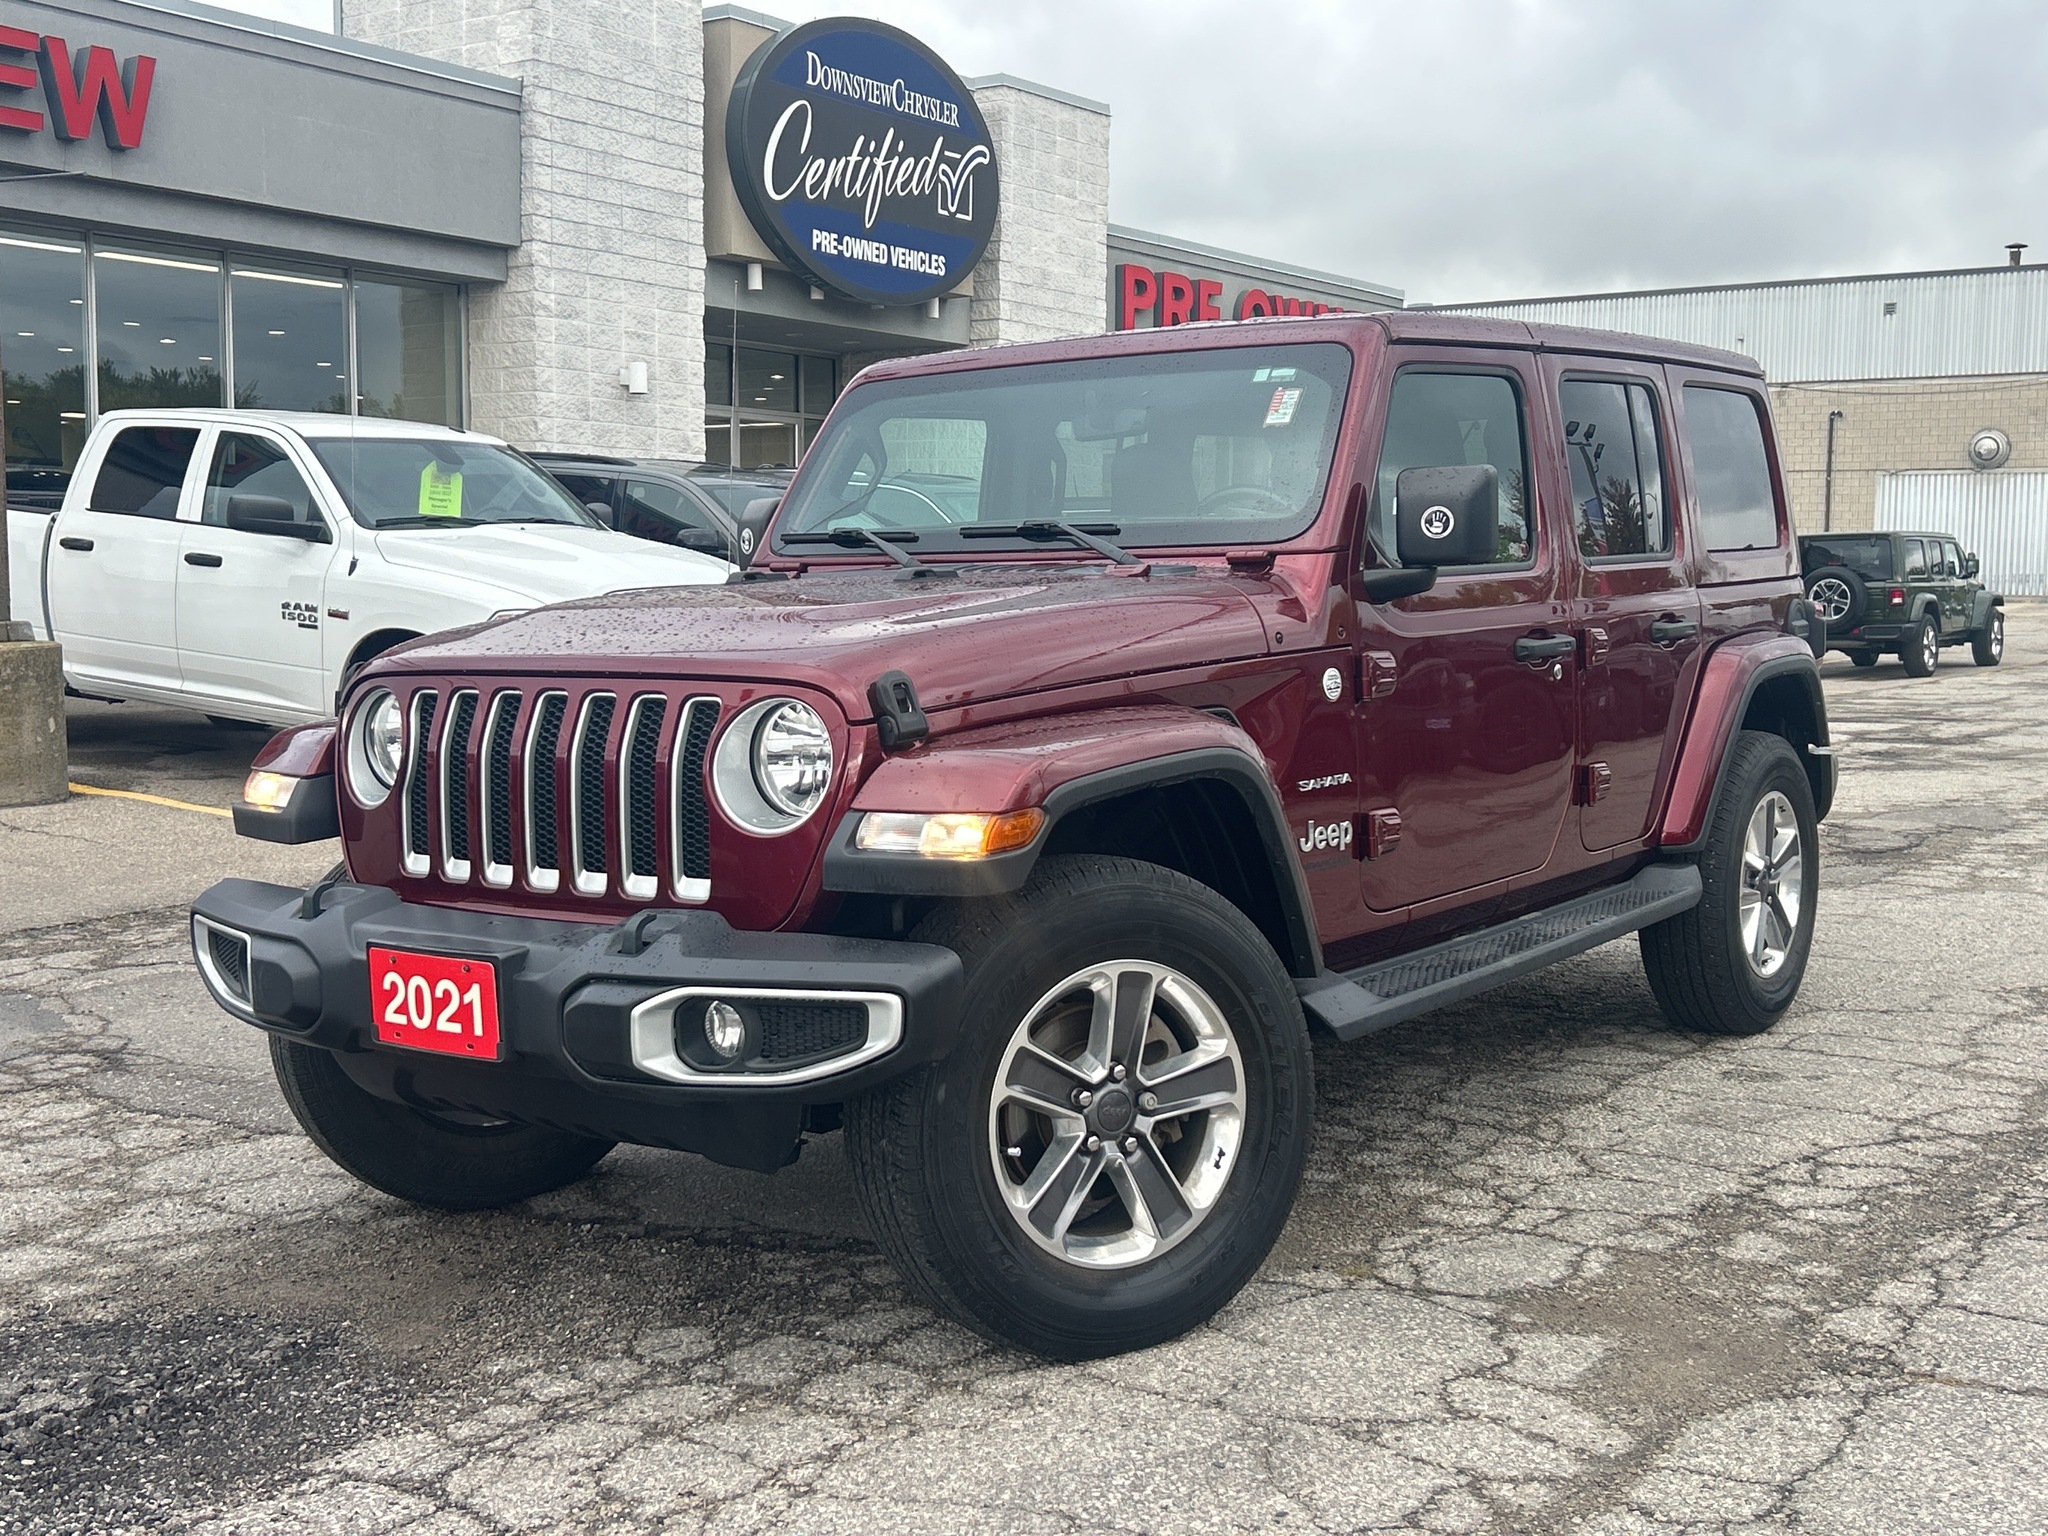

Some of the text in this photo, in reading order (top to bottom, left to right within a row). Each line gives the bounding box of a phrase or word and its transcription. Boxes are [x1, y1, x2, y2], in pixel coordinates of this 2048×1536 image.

[763, 99, 944, 229] Certified
[812, 228, 946, 277] PRE-OWNED VEHICLES
[281, 601, 318, 613] RAM
[281, 611, 318, 623] 1500
[1298, 772, 1352, 792] SAHARA
[1299, 819, 1354, 853] Jeep
[381, 970, 485, 1038] 2021
